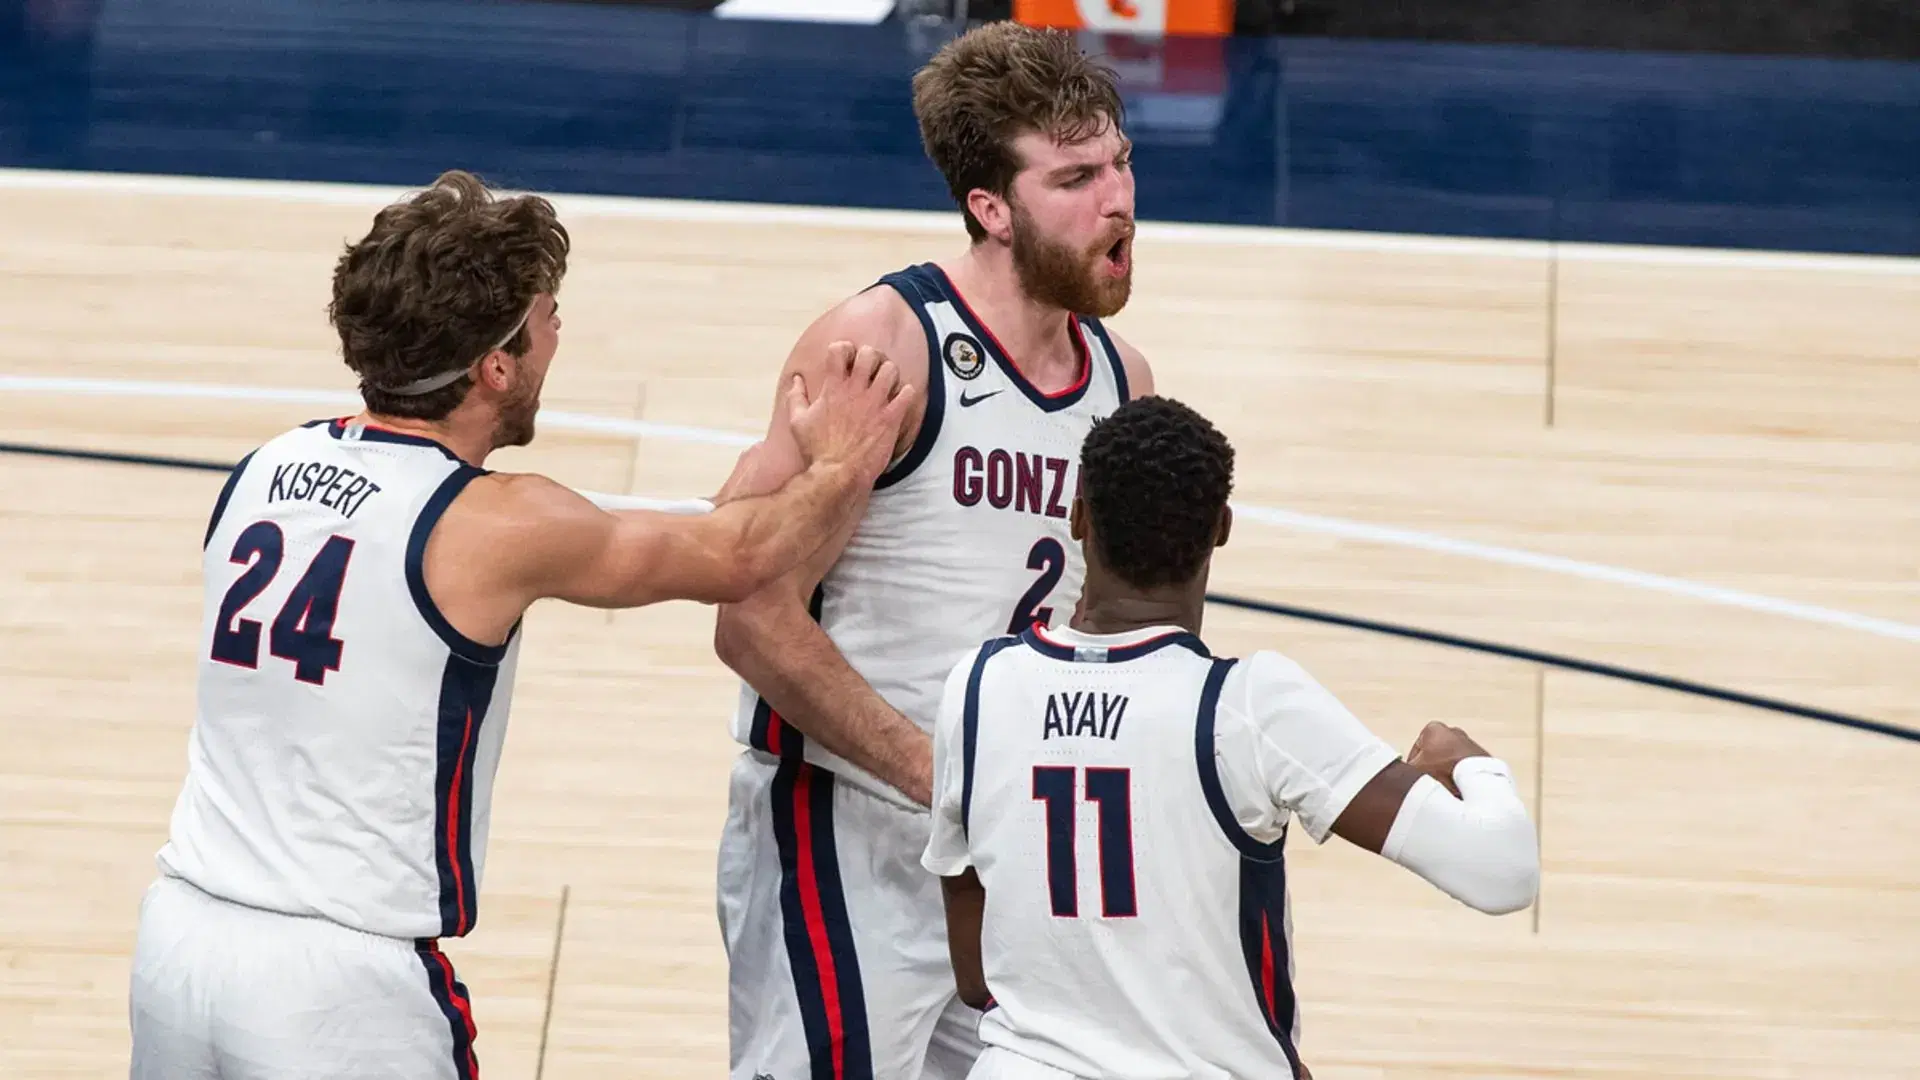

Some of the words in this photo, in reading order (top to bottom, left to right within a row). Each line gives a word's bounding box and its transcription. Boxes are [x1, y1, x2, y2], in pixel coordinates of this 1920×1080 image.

[268, 462, 381, 519] KISPERT
[953, 446, 1084, 519] GONZ
[210, 519, 356, 686] 24
[1006, 536, 1066, 633] 2
[1043, 691, 1129, 741] AYAYI
[1032, 765, 1138, 918] 11
